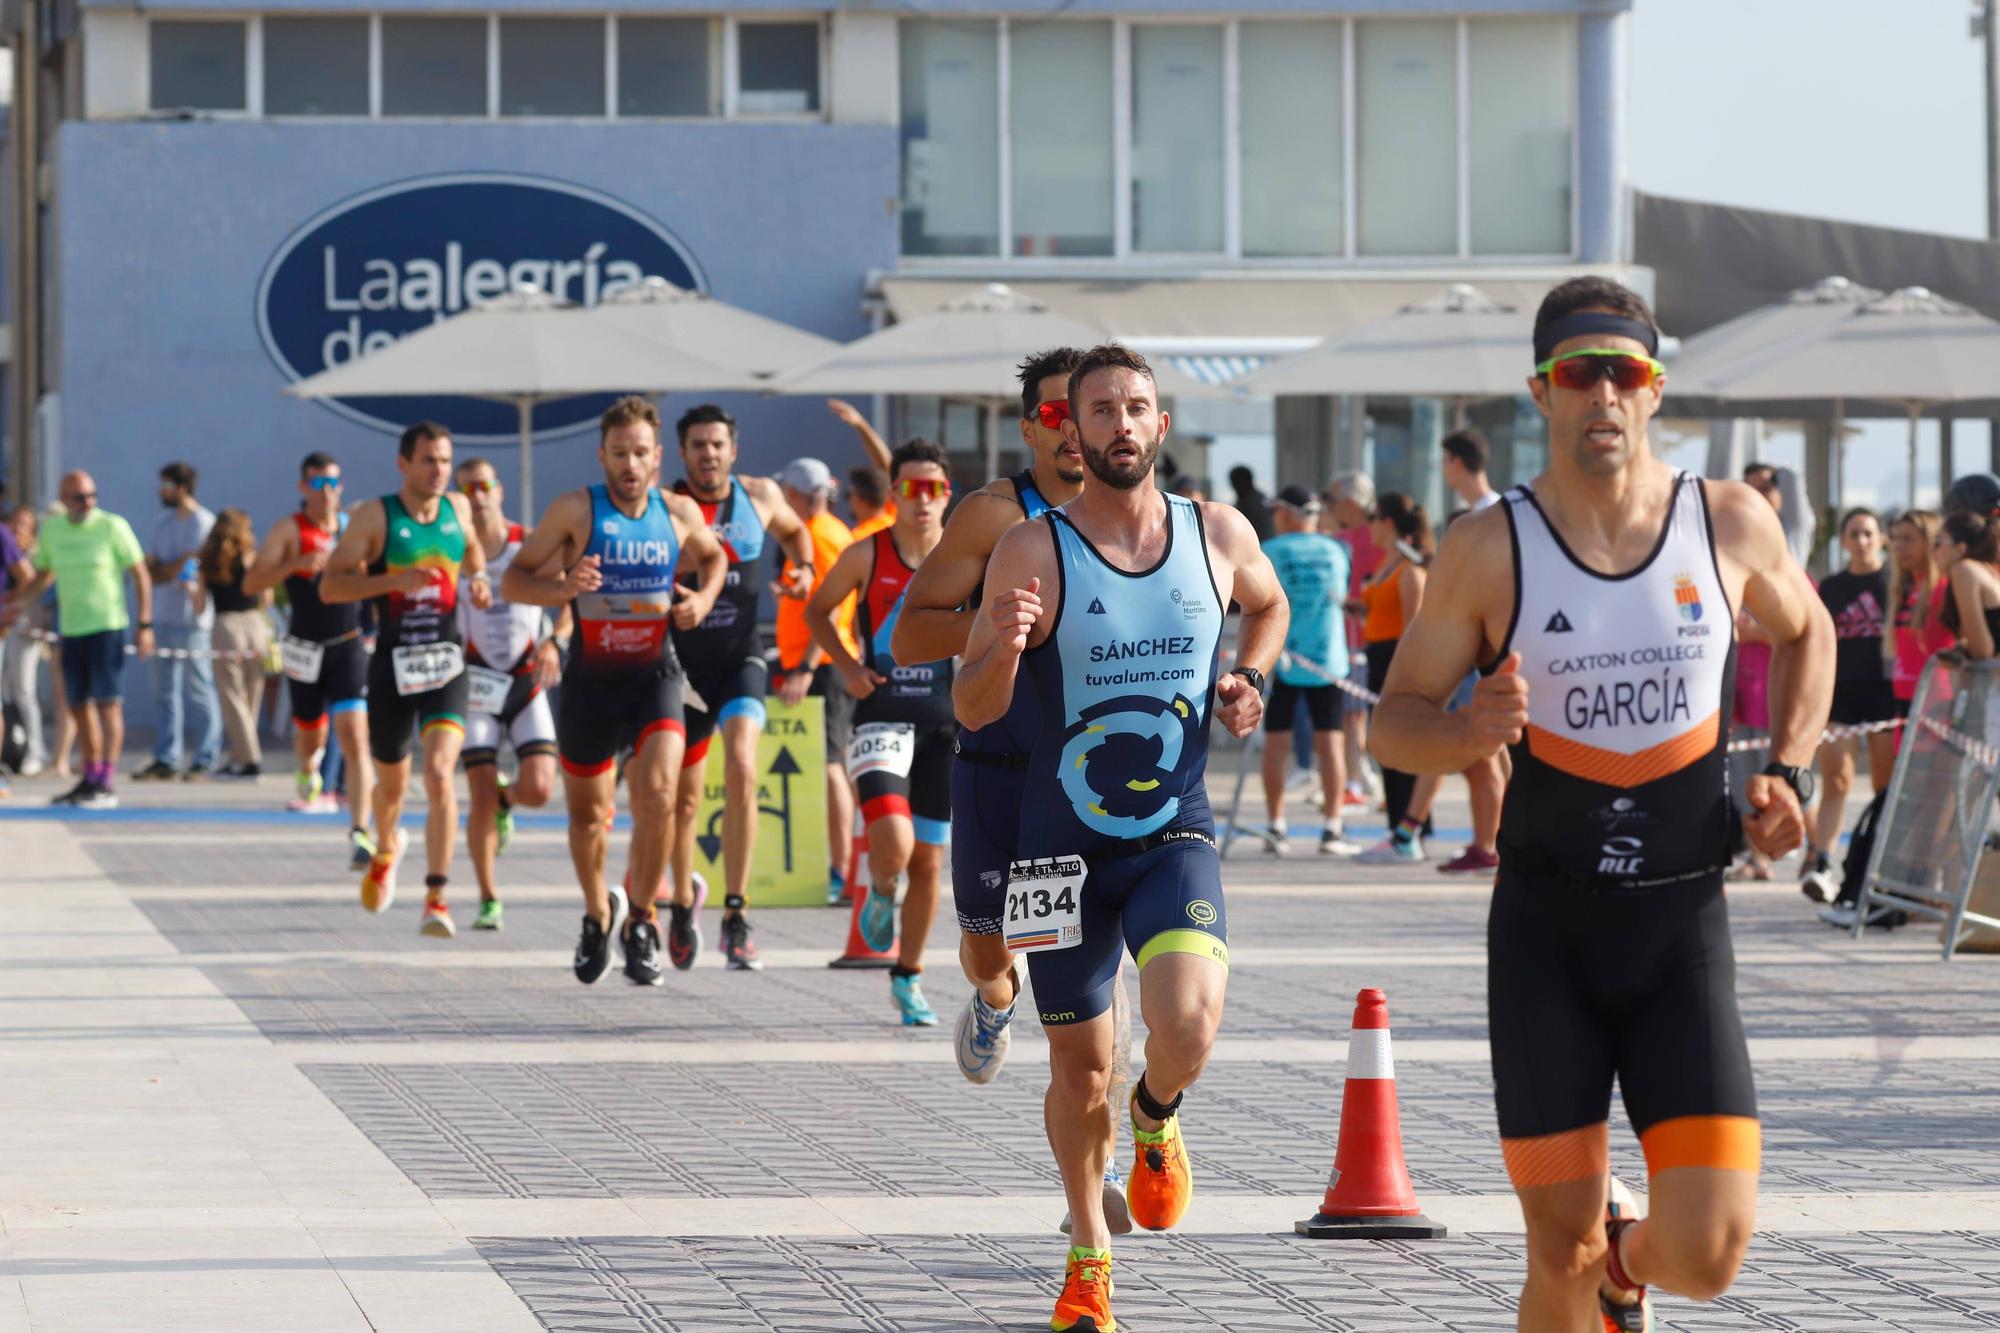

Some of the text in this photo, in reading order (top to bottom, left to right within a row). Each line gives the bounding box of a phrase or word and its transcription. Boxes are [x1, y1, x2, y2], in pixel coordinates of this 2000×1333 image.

[603, 540, 670, 566] LLUCH
[1090, 637, 1194, 662] SÁNCHEZ
[1548, 645, 1705, 676] CAXTON COLLEGE
[1086, 668, 1194, 686] tuvalum.com
[1565, 667, 1690, 730] GARCÍA
[765, 718, 807, 735] ETA
[1041, 860, 1080, 874] TRATLÓ
[1598, 857, 1644, 874] RLC
[1008, 886, 1077, 922] 2134
